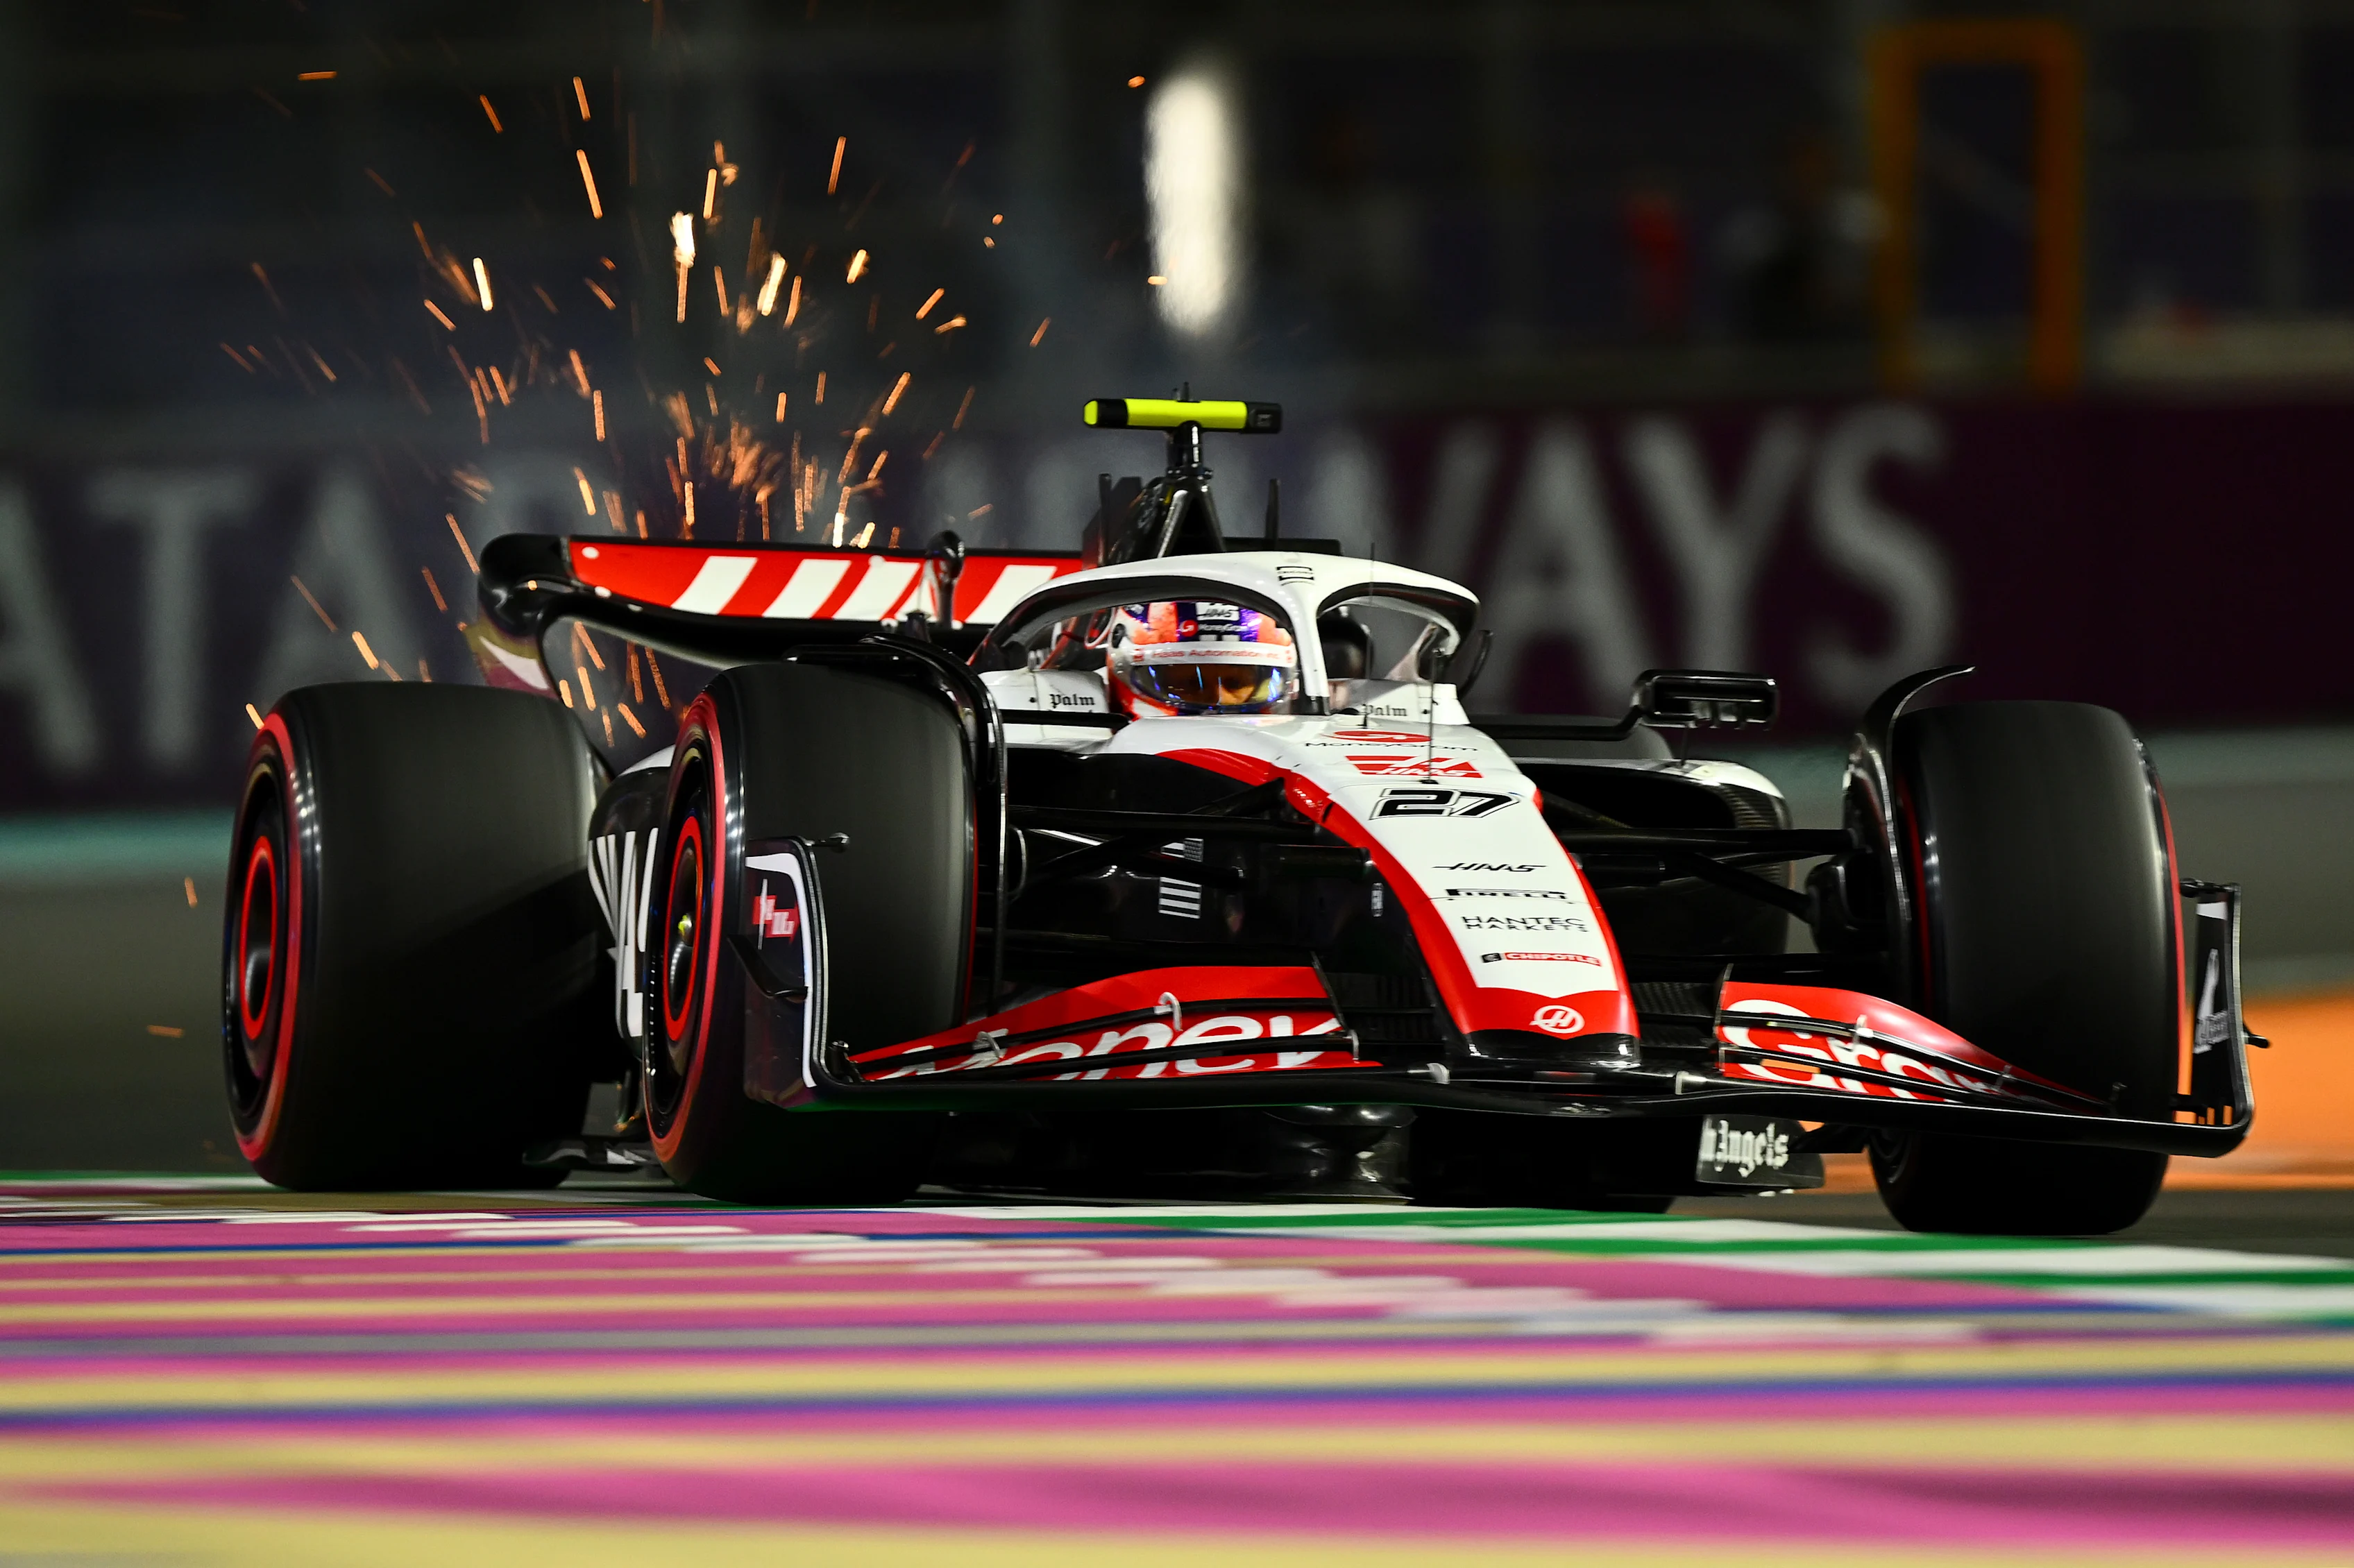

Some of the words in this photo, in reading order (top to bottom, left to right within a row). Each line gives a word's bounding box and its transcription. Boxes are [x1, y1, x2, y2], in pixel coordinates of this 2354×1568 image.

[1049, 694, 1095, 708] Palm
[1362, 704, 1407, 717] Palm
[1305, 743, 1477, 751] MoneyGram
[1376, 767, 1468, 776] HAAS
[1371, 789, 1520, 819] 27
[1432, 862, 1548, 872] HAAS
[1446, 889, 1567, 900] PIRELLI
[1462, 916, 1585, 926] HANTEC
[1466, 923, 1589, 932] MARKETS
[1505, 953, 1600, 965] CHIPOTLE
